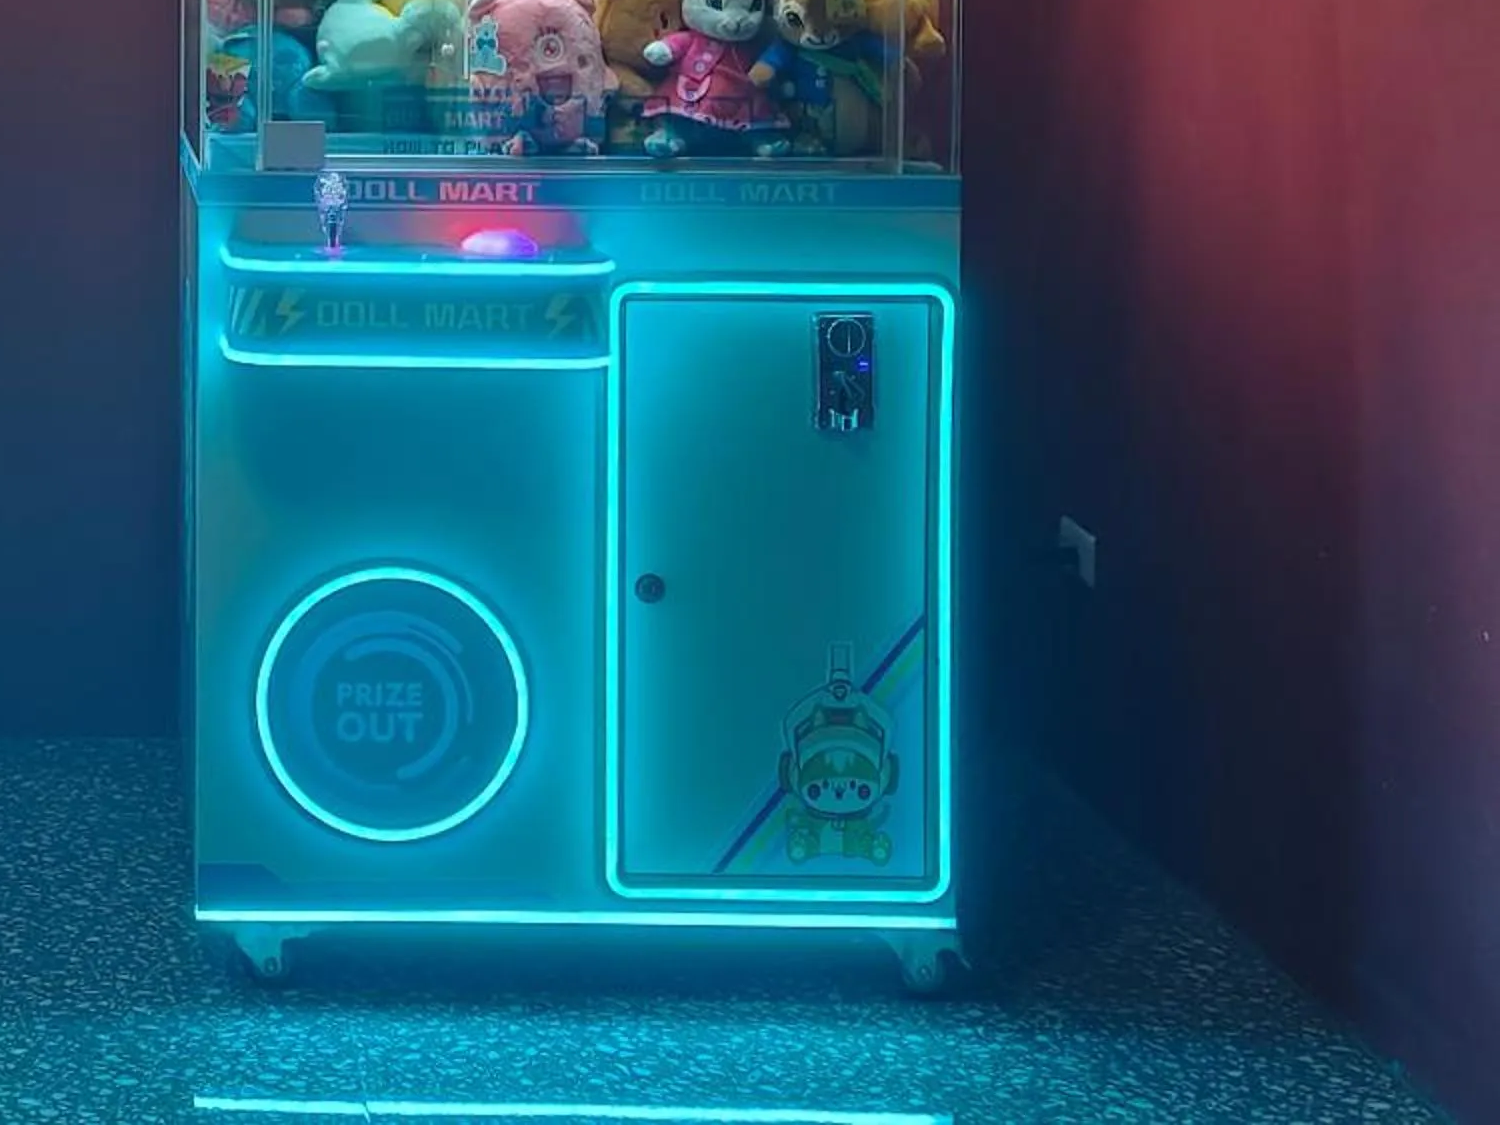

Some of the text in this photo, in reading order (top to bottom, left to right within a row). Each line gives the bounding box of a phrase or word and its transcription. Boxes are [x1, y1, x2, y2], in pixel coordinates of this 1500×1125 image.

[346, 179, 541, 202] DOLL MART
[641, 182, 840, 203] DOLL MART
[315, 298, 533, 330] DOLL MART
[336, 683, 422, 707] PRIZE
[336, 713, 421, 743] OUT
